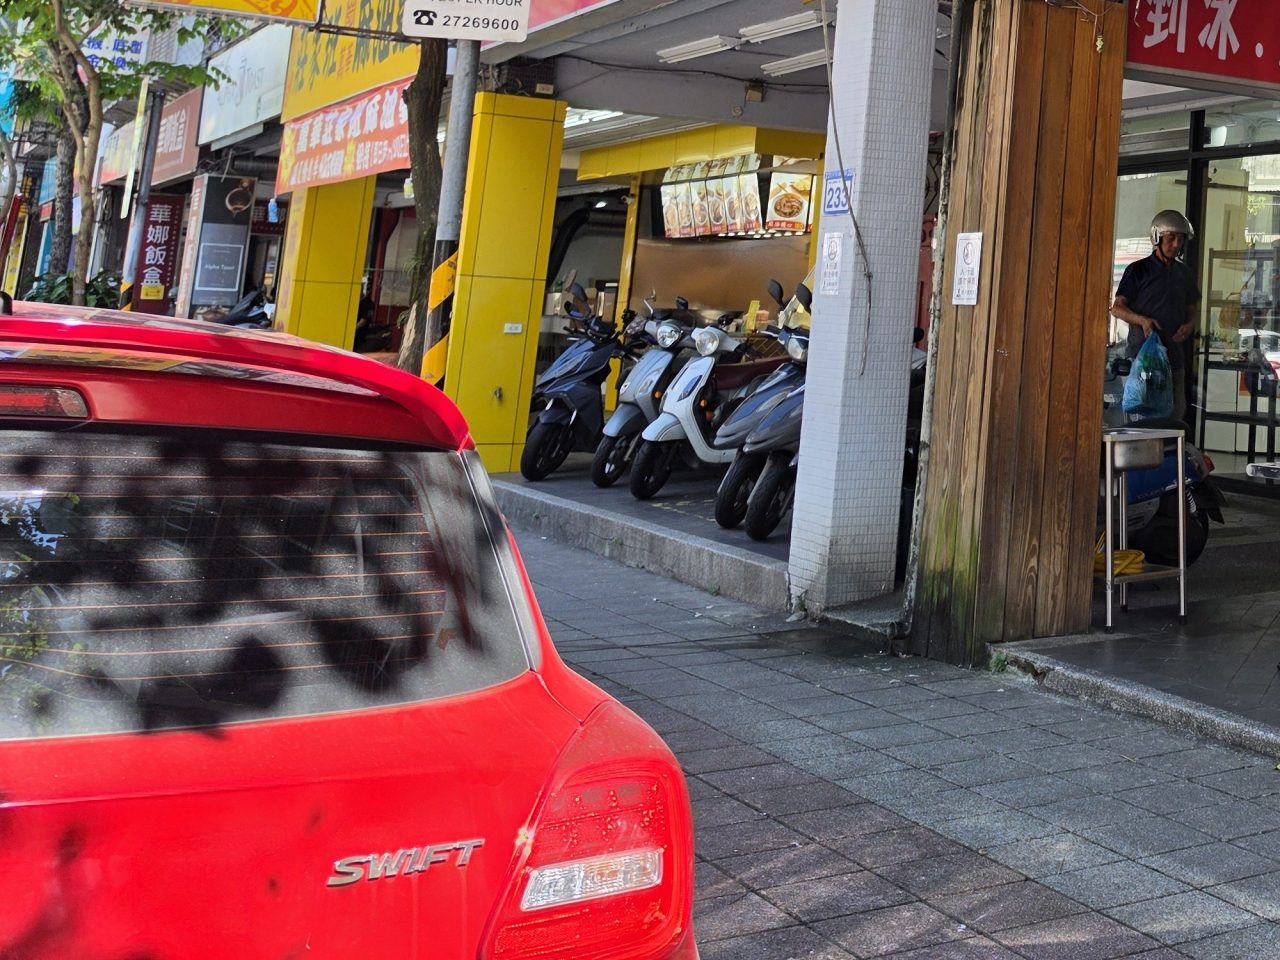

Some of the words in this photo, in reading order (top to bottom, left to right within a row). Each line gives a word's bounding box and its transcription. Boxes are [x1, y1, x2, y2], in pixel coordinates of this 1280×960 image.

[442, 14, 519, 31] 27269600
[826, 186, 848, 209] 233
[140, 204, 173, 286] 華娜飯盒
[327, 838, 486, 887] SWIFT
